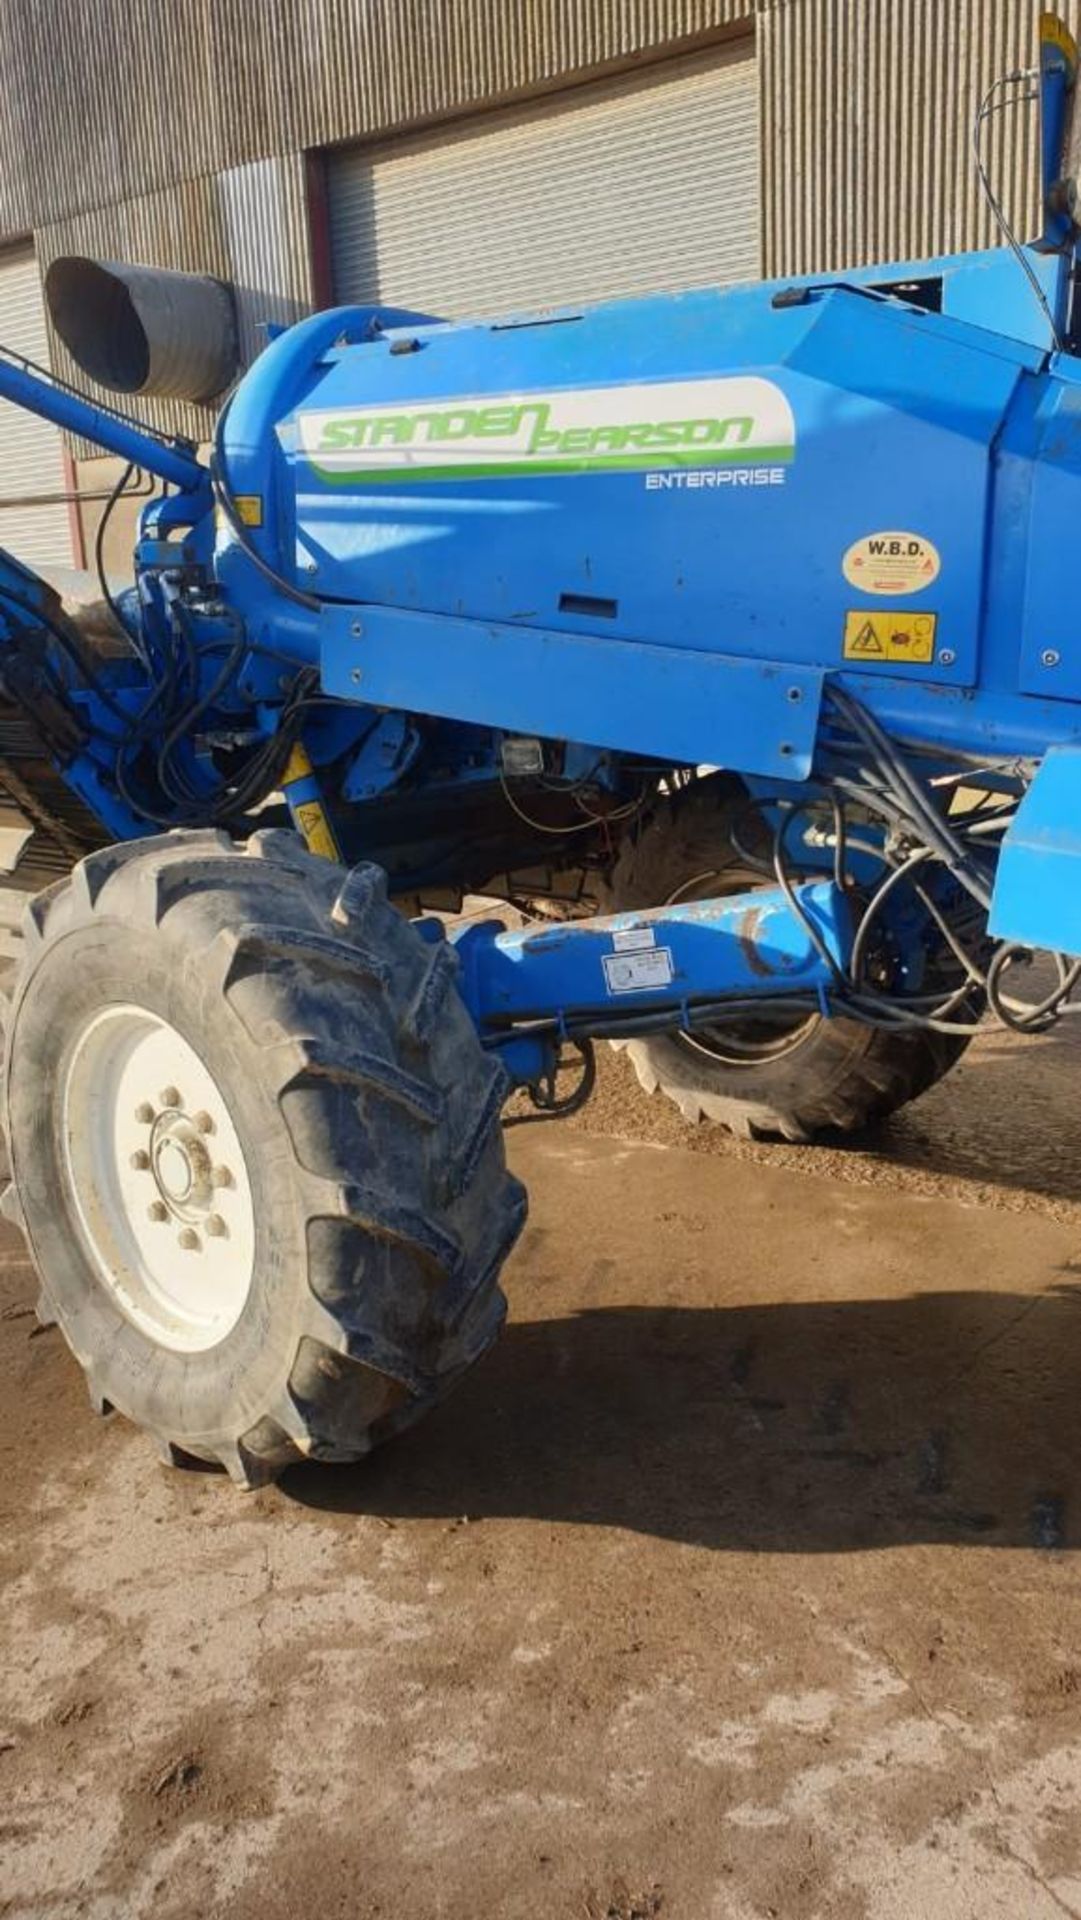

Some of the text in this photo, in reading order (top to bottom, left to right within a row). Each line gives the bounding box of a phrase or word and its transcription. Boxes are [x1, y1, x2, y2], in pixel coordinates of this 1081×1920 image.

[318, 403, 754, 455] STANDEN PEARSON
[645, 467, 786, 490] ENTERPRISE
[868, 541, 924, 556] W.B.D.
